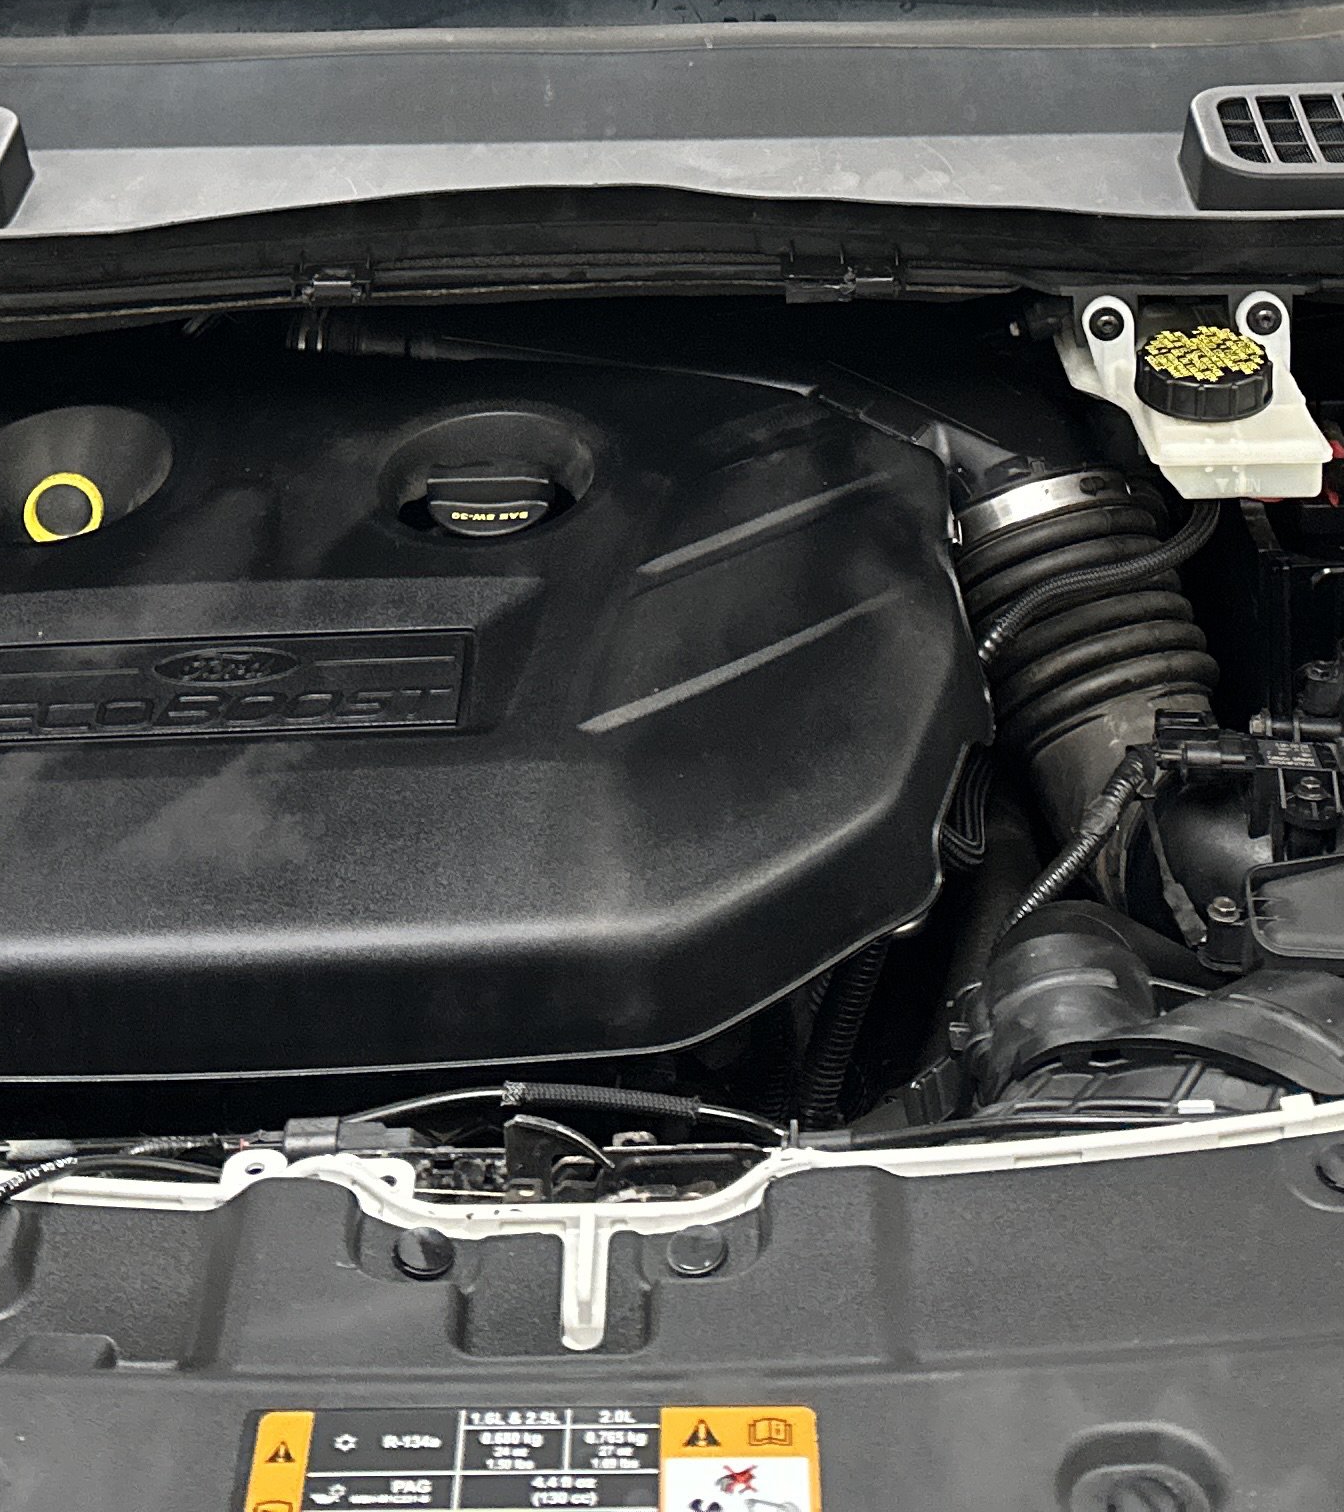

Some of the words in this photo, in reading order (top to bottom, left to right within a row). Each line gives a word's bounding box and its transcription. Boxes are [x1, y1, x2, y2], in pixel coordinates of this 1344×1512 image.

[470, 1411, 506, 1426] 1.6L
[507, 1411, 522, 1425] &
[525, 1410, 561, 1425] 2.5L
[598, 1409, 637, 1424] 2.0L
[381, 1434, 443, 1449] R-134a
[523, 1431, 545, 1448] kg
[627, 1431, 648, 1447] kg
[390, 1479, 433, 1494] PAG
[574, 1477, 598, 1489] oz
